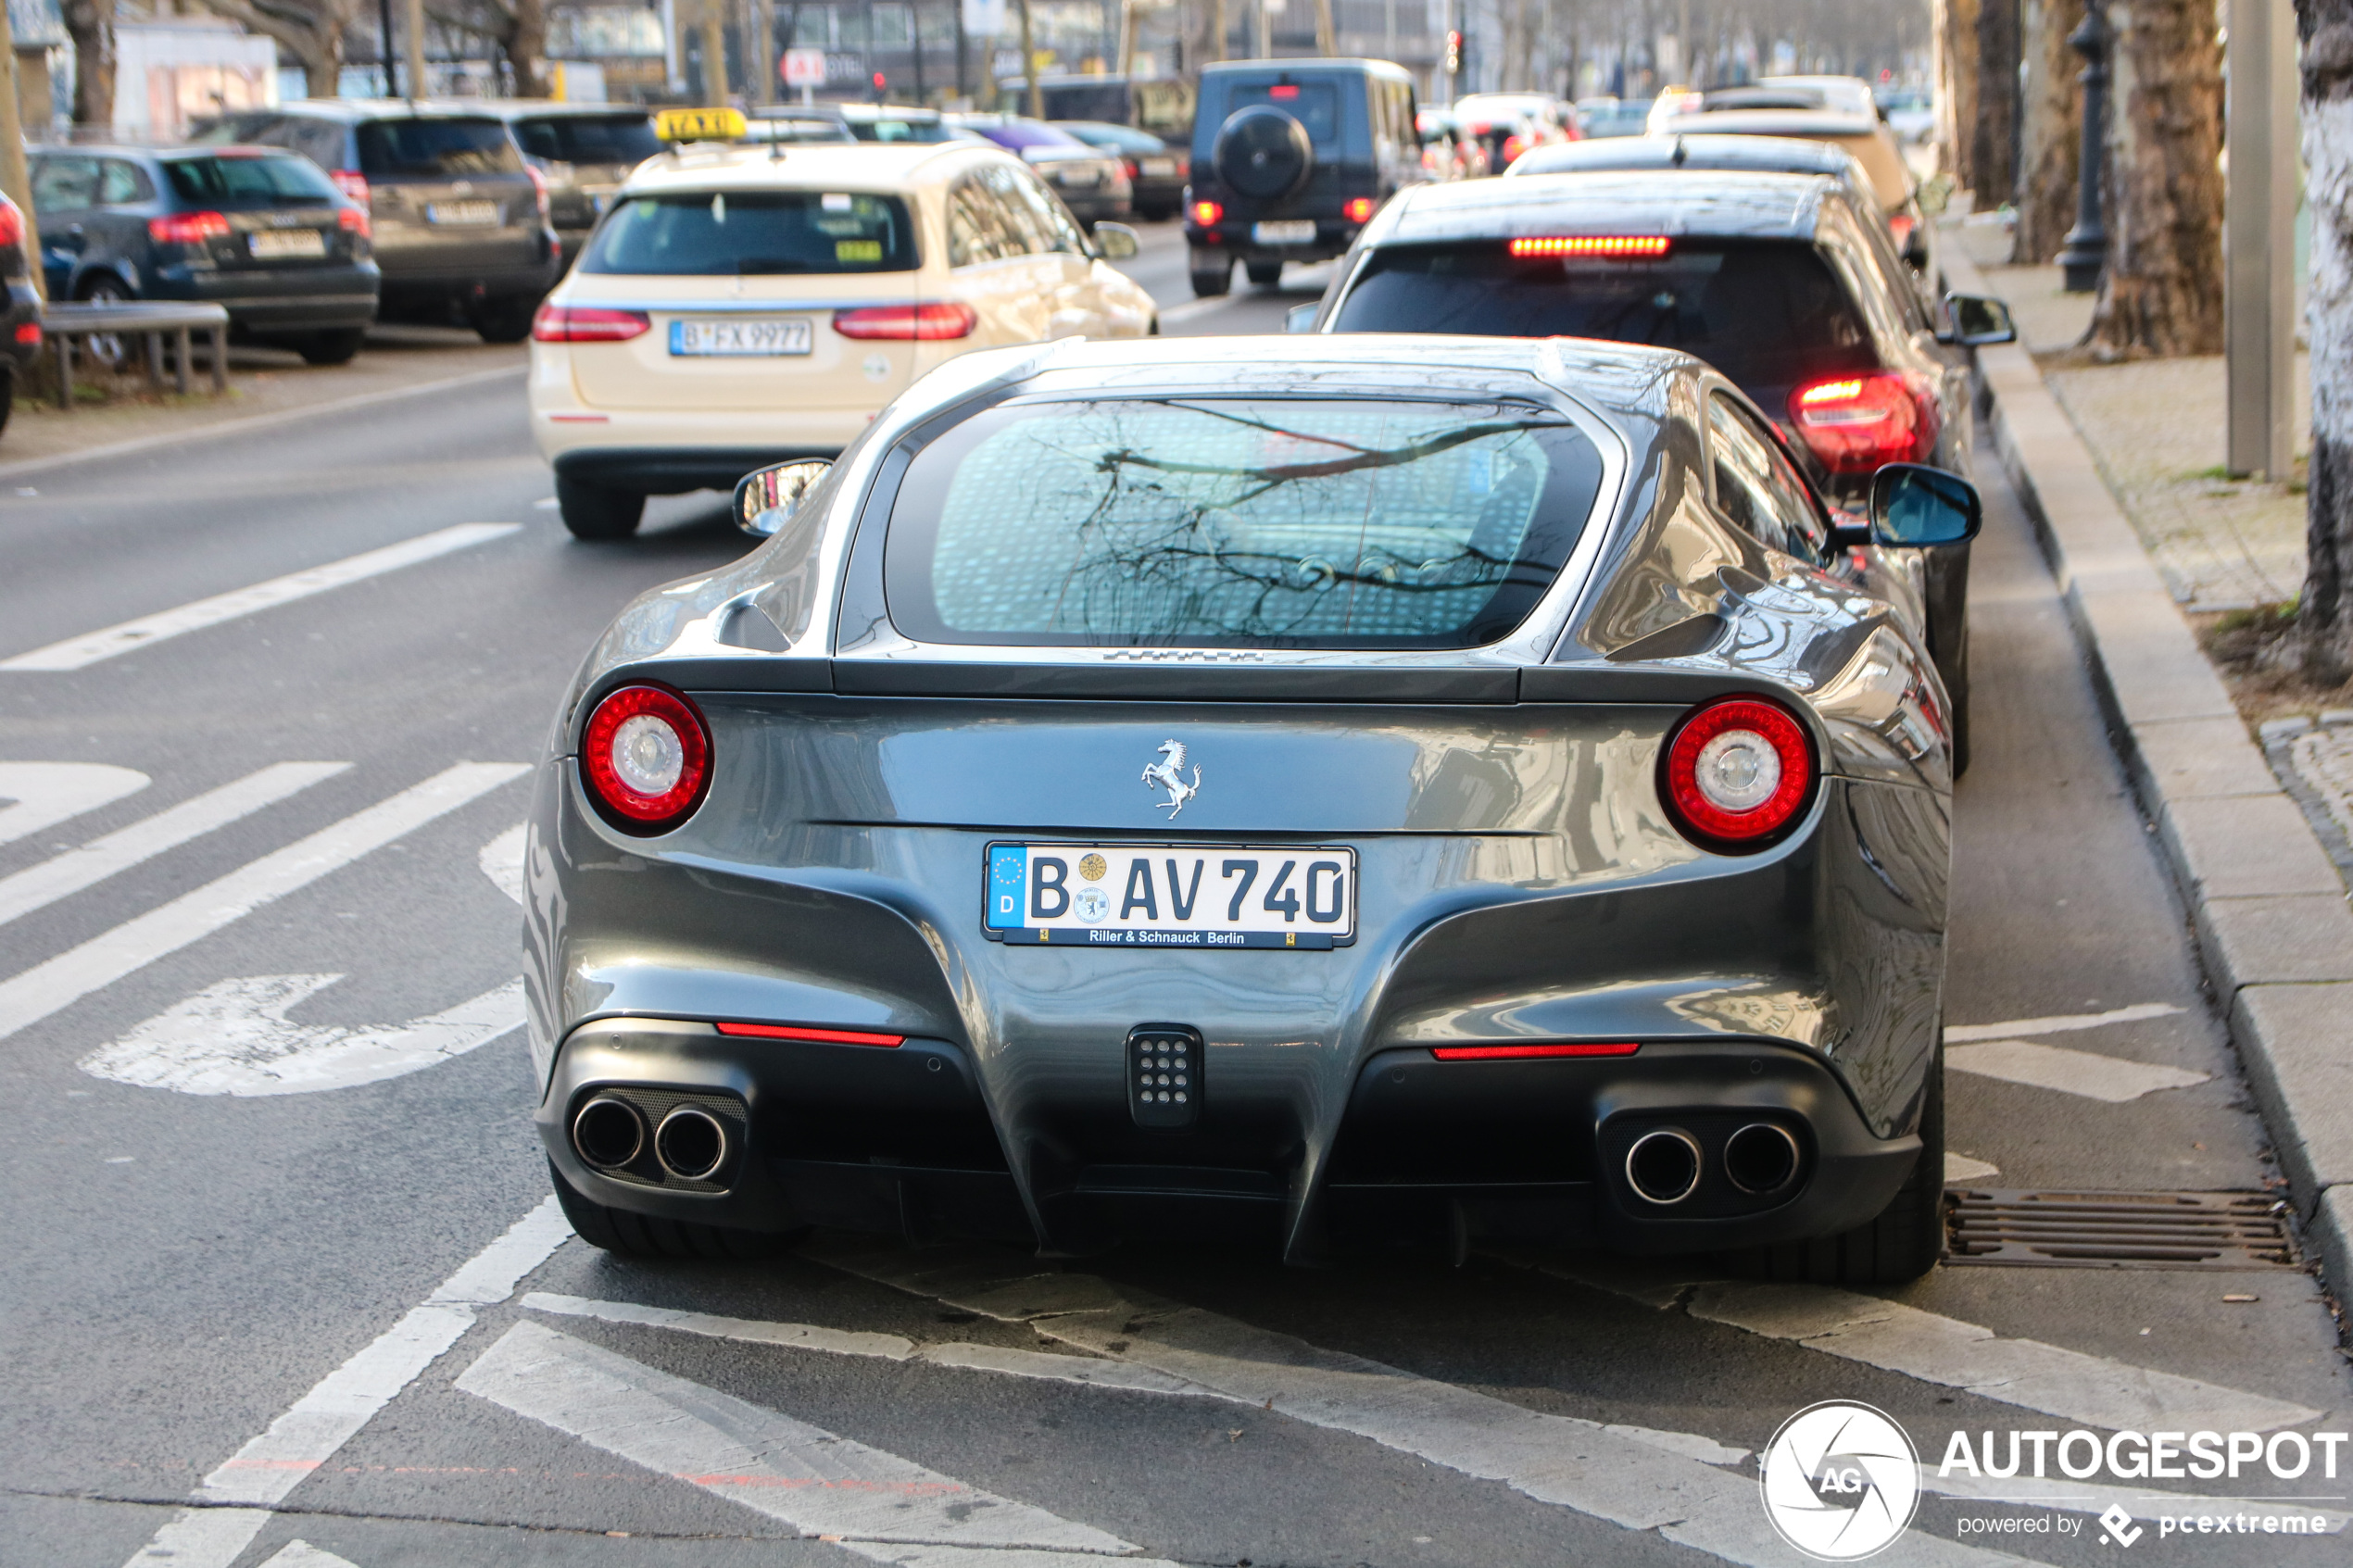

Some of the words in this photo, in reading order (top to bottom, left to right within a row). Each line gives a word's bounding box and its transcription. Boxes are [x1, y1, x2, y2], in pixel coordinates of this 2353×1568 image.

[669, 112, 728, 136] TAXI
[685, 324, 698, 346] B
[715, 324, 744, 346] FX
[750, 323, 806, 346] 9977
[1031, 857, 1070, 919] B
[1119, 859, 1204, 921] AV
[1222, 859, 1343, 923] 740
[1000, 895, 1014, 913] D
[1089, 929, 1123, 943] Riller
[1125, 930, 1135, 943] &
[1139, 930, 1201, 944] Schnauck
[1207, 931, 1245, 945] Berlin
